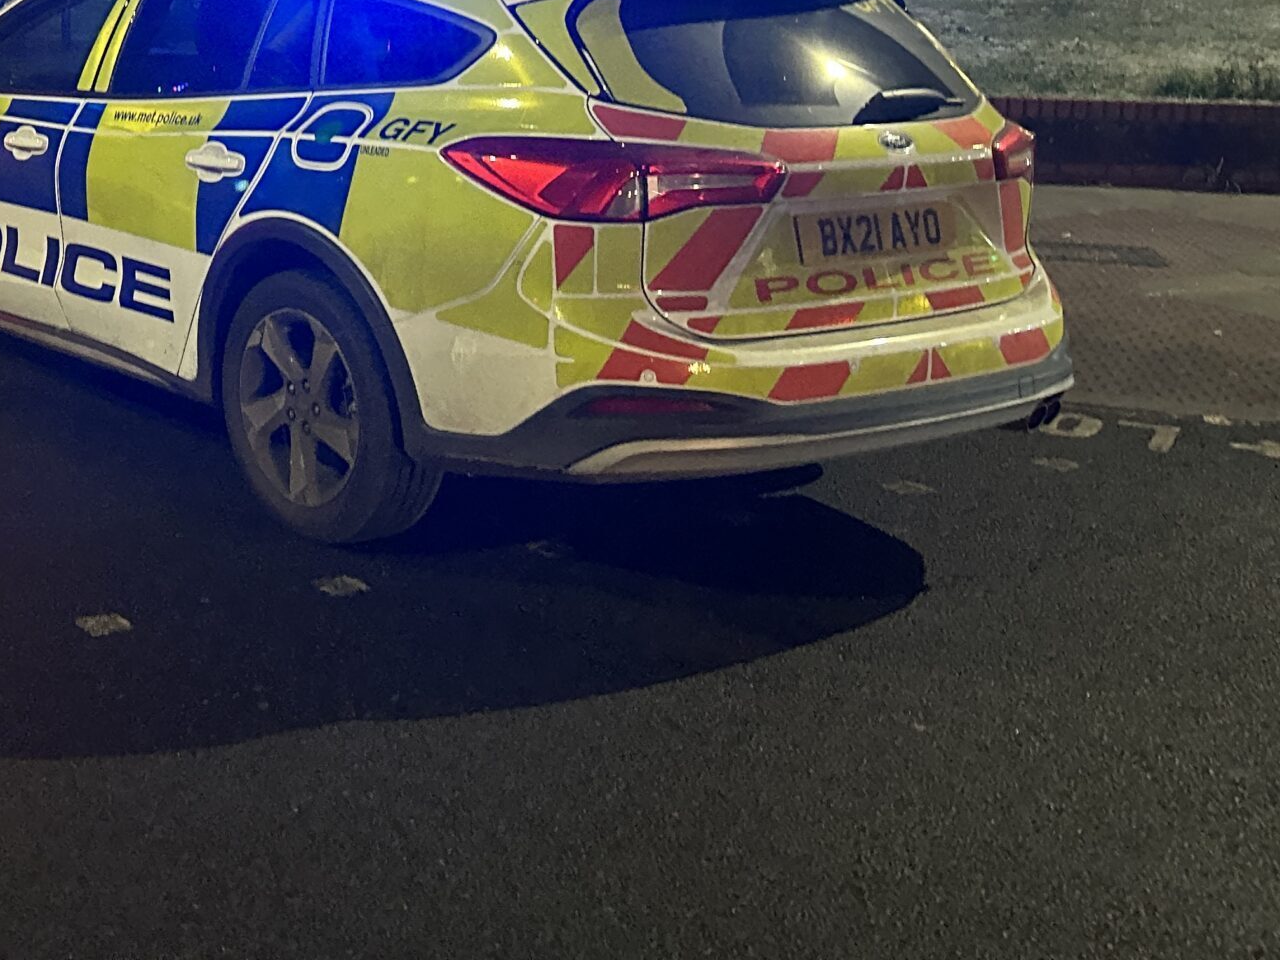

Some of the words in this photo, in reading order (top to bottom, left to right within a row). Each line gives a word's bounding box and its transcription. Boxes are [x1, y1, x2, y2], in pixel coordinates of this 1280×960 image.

[113, 109, 202, 127] www.met.police.uk
[379, 117, 457, 145] GFY
[818, 212, 883, 257] BX21
[754, 251, 996, 303] POLICE
